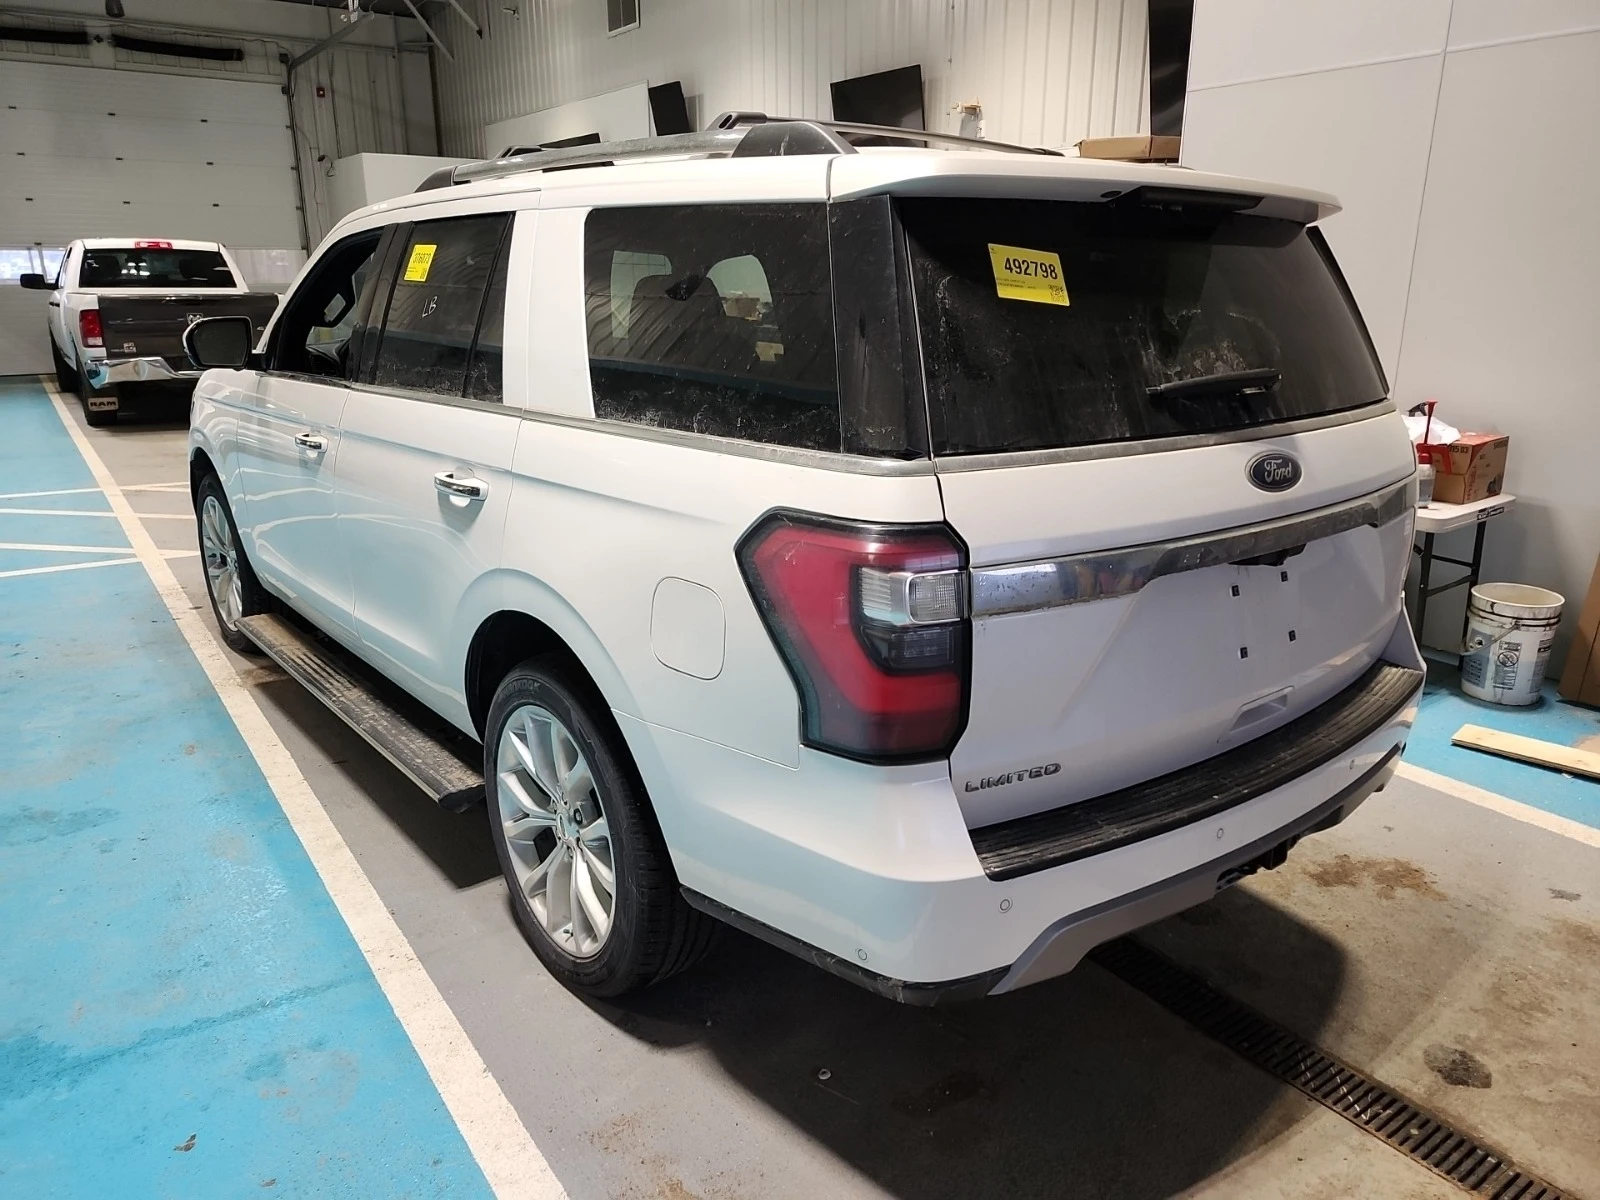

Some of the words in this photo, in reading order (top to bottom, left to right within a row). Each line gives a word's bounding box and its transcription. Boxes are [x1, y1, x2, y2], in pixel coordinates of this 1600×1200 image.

[1004, 257, 1058, 280] 492798
[421, 295, 438, 318] LB
[1264, 459, 1292, 483] Ford
[965, 763, 1062, 793] LIMITED
